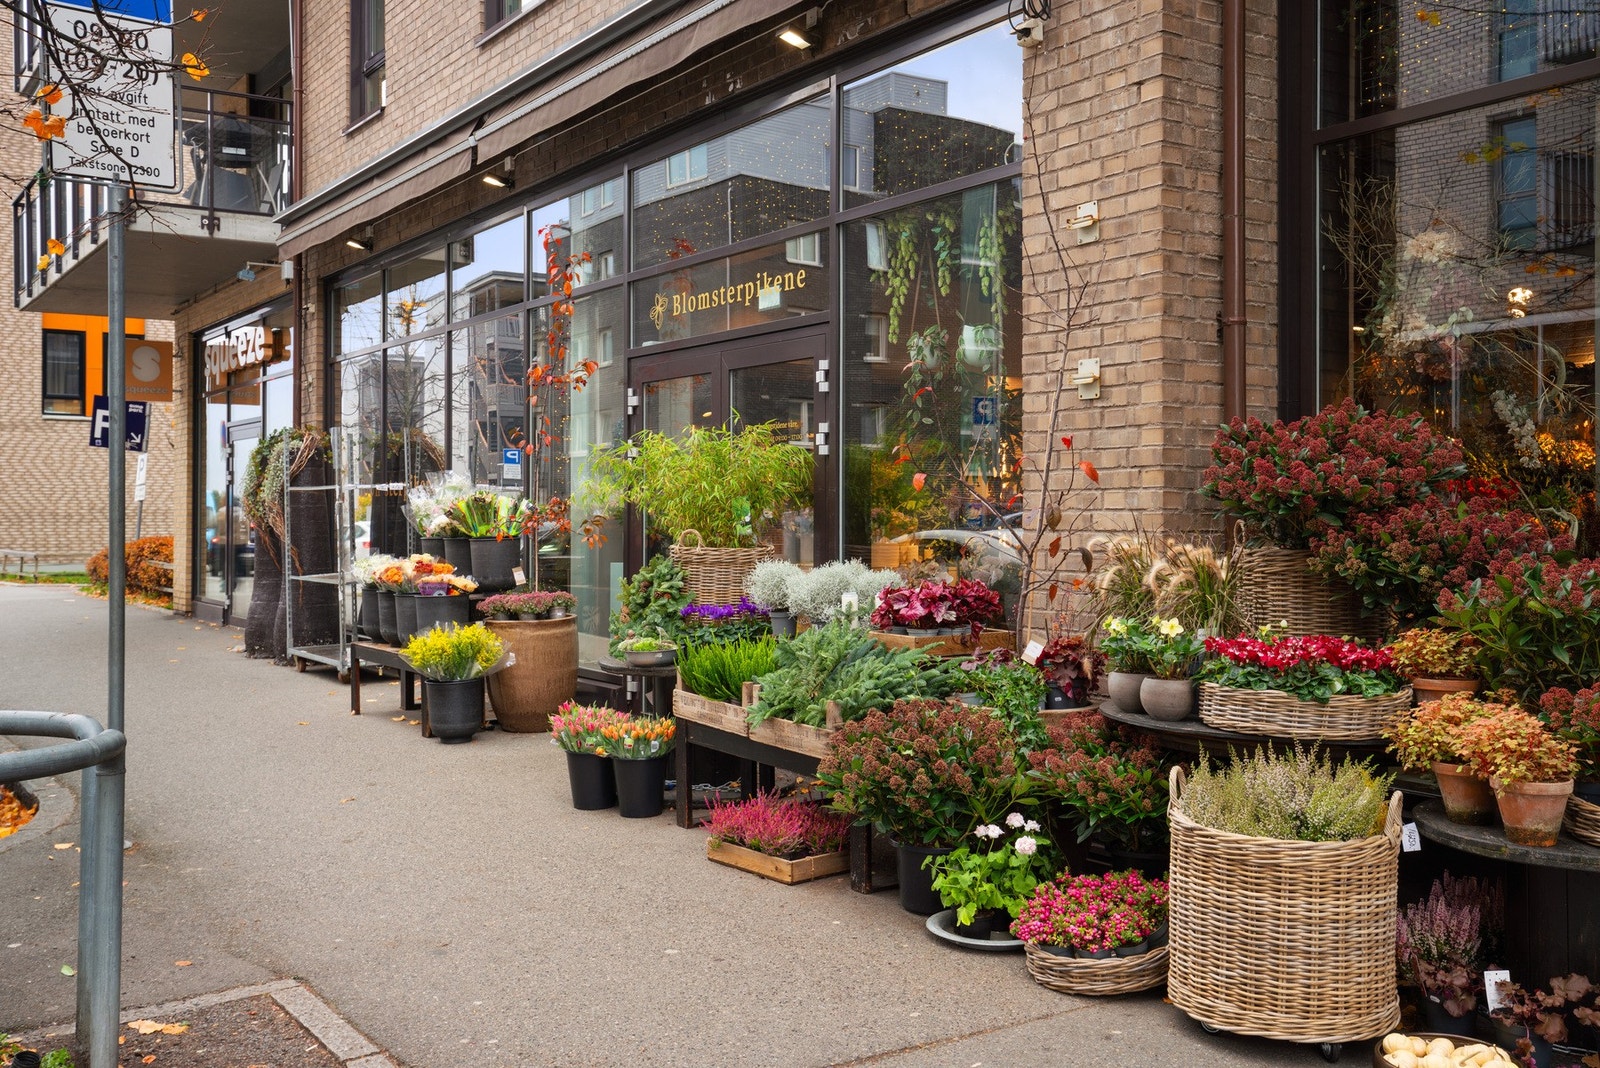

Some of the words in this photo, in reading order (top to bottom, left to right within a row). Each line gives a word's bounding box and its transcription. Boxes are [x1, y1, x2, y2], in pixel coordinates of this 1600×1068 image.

[128, 115, 155, 128] med
[131, 146, 140, 158] D
[69, 156, 126, 173] Takstsone
[672, 269, 806, 316] Blomsterpikene
[204, 326, 265, 386] squeeze
